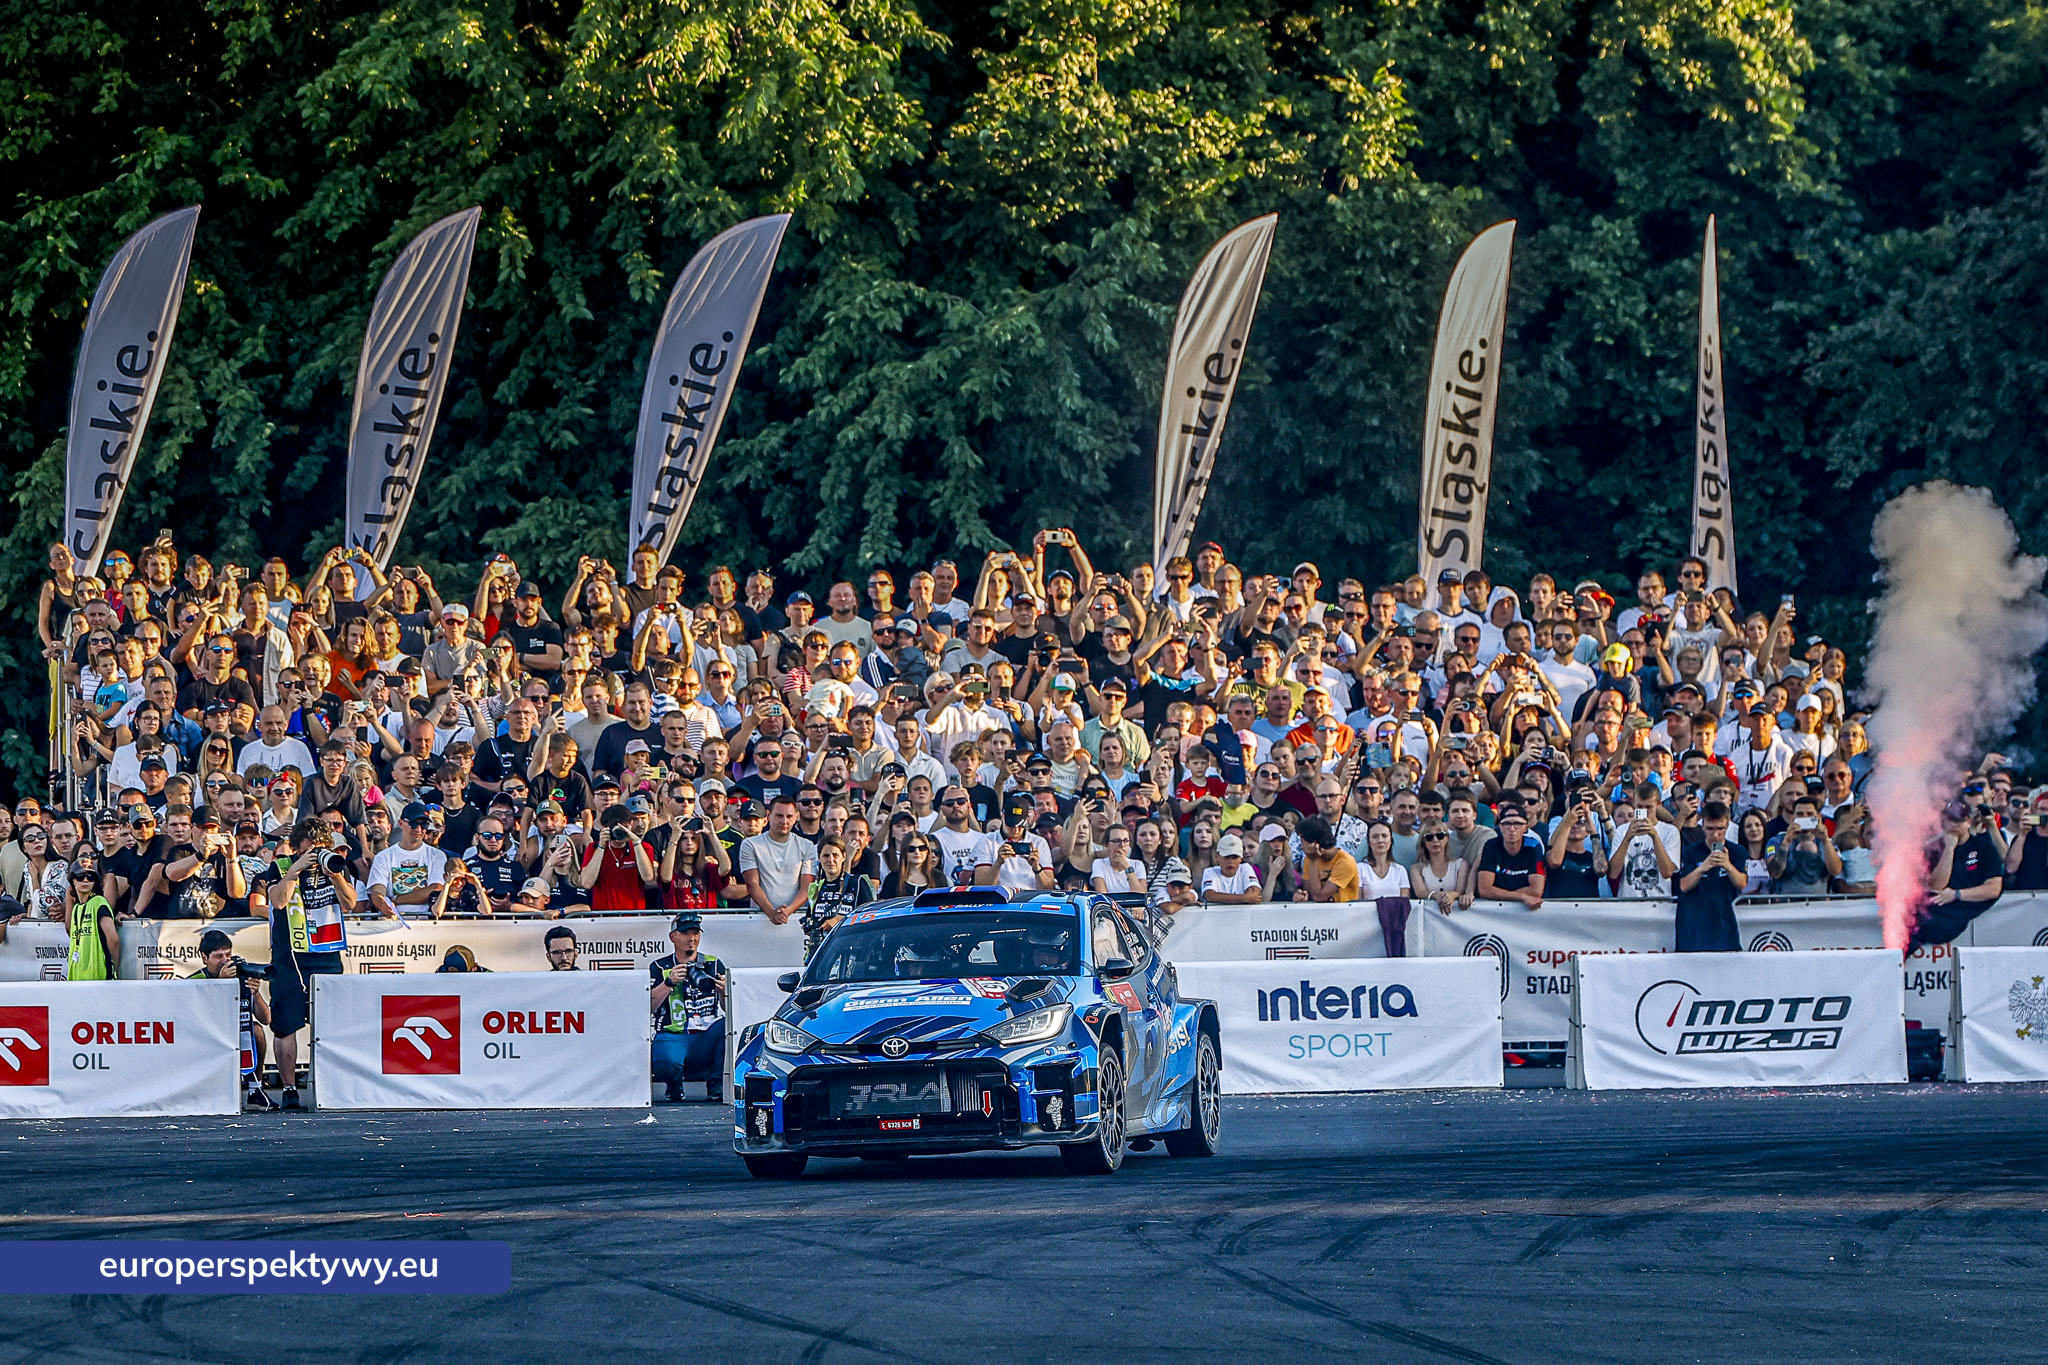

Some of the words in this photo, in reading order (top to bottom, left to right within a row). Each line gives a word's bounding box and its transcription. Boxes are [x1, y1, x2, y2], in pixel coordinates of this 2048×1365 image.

[849, 910, 878, 926] 15
[293, 923, 306, 950] POL
[1251, 930, 1298, 942] STADION
[1301, 926, 1338, 945] ŚLĄSKI
[35, 947, 57, 959] STADION
[138, 946, 163, 959] STADION
[166, 944, 200, 962] ŚLĄSK
[345, 945, 393, 957] STADION
[397, 942, 436, 960] ŚLĄSKI
[575, 941, 622, 954] STADION
[626, 938, 665, 957] ŚLĄSKI
[1526, 976, 1570, 994] STAD
[1257, 980, 1418, 1021] interia
[1685, 996, 1852, 1026] MOTO
[483, 1011, 584, 1034] ORLEN
[71, 1021, 174, 1045] ORLEN
[1681, 1030, 1837, 1051] WIZJA
[483, 1042, 520, 1059] OIL
[1288, 1033, 1392, 1059] SPORT
[72, 1053, 110, 1070] OIL
